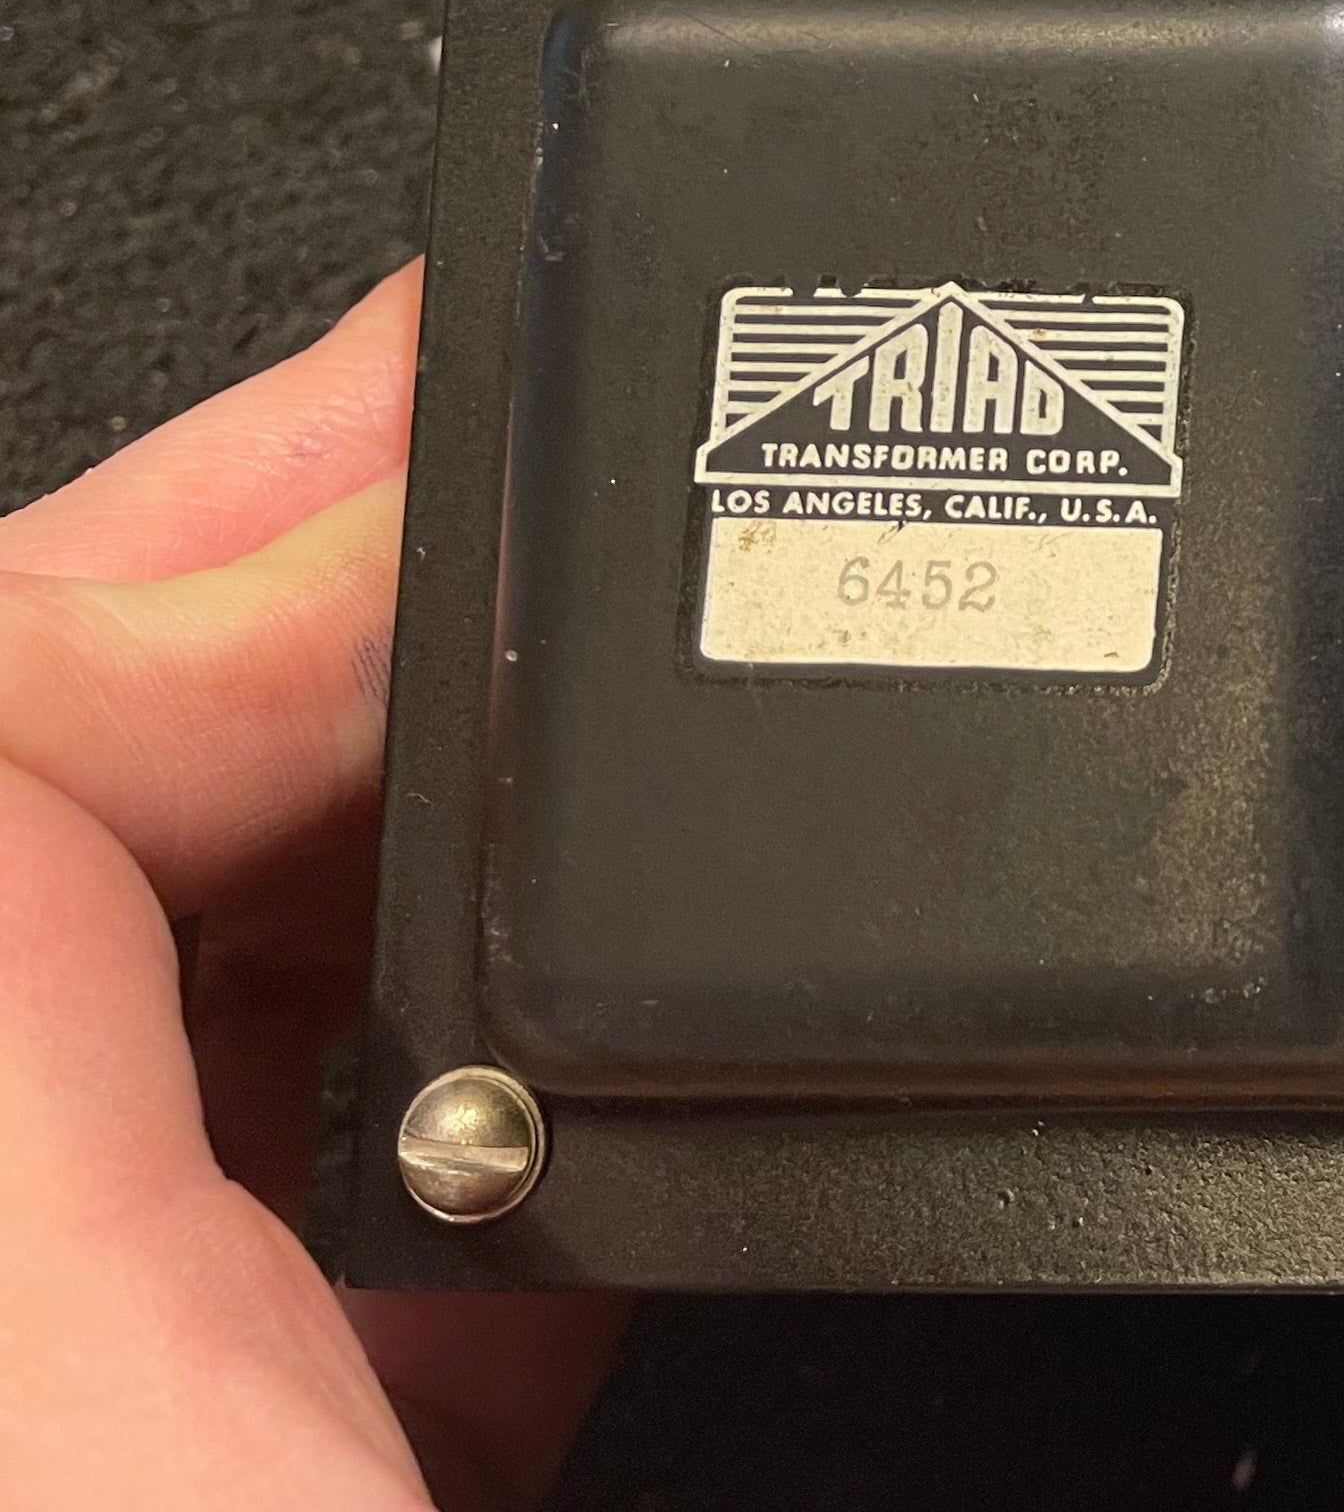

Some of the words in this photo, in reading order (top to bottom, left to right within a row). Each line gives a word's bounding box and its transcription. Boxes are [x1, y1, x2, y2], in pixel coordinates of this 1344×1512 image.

[812, 300, 1064, 436] TRIAD
[761, 442, 1008, 473] TRANSFORMER
[1025, 448, 1129, 476] CORP.
[711, 489, 770, 514] LOS
[782, 491, 932, 520] ANGELES,
[944, 495, 1048, 524] CALIF.,
[1060, 499, 1158, 524] U.S.A.
[836, 556, 999, 612] 6452
